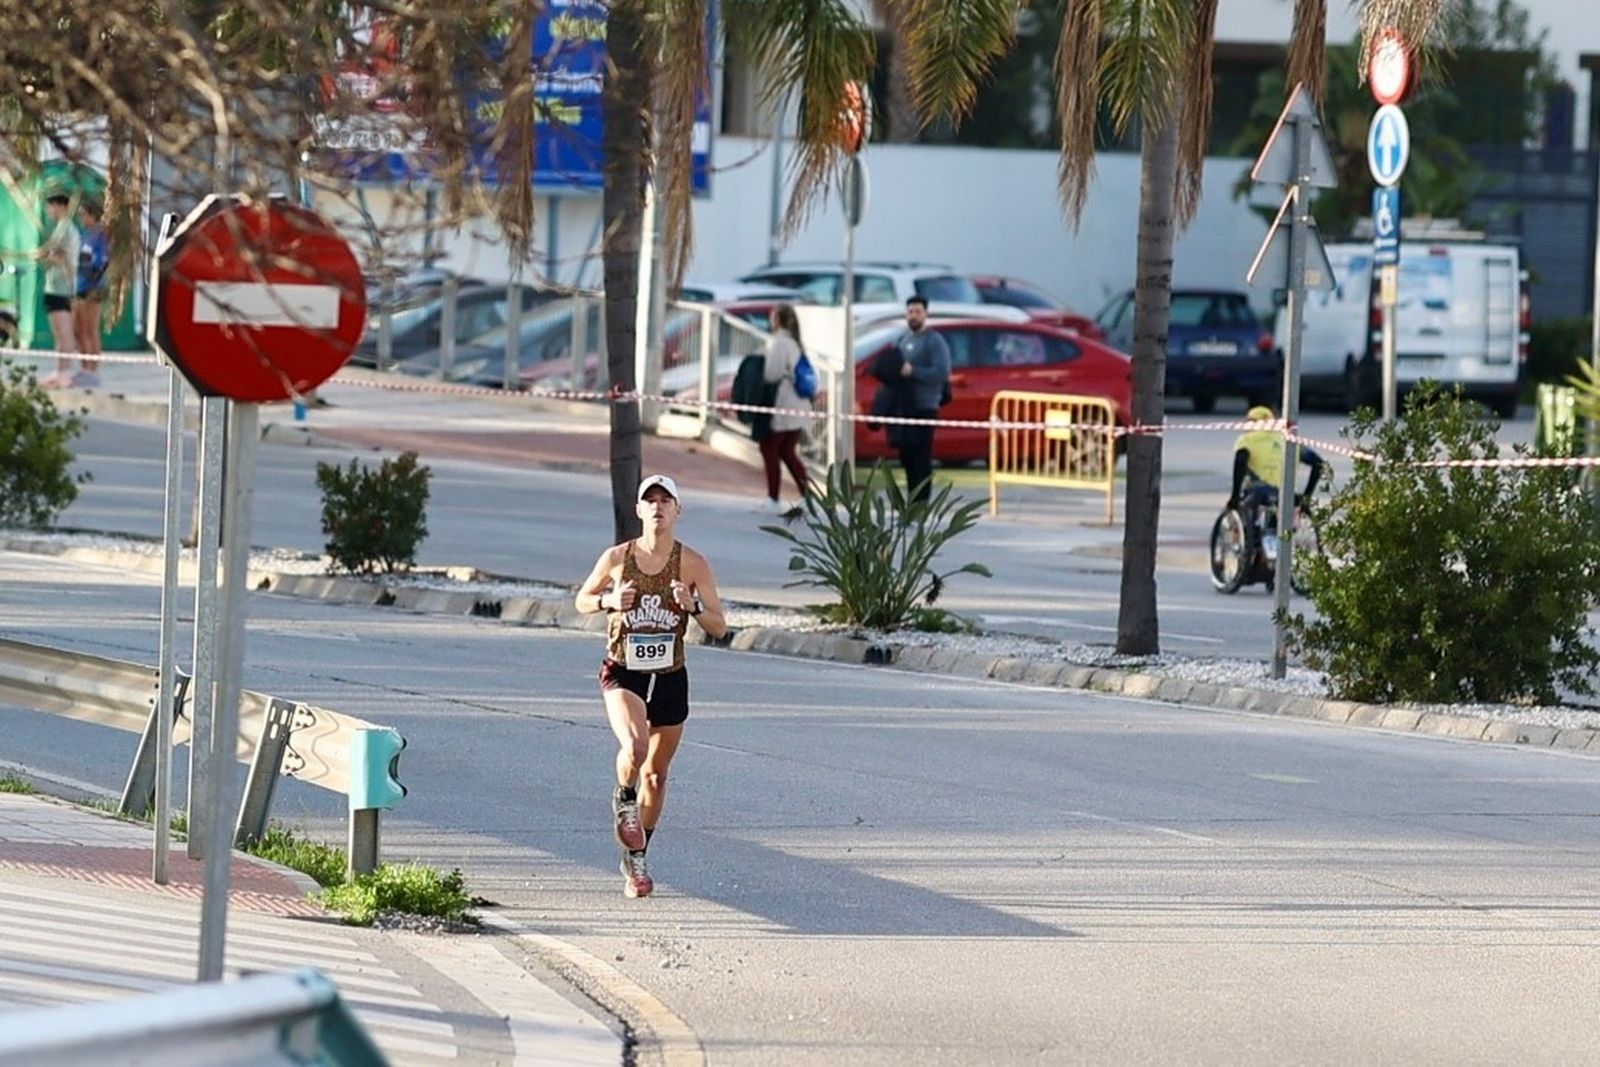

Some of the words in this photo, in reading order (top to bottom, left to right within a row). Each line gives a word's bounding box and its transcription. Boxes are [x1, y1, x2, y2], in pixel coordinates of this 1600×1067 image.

[641, 595, 661, 609] GO
[622, 607, 681, 628] TRAINING
[635, 644, 667, 659] 899
